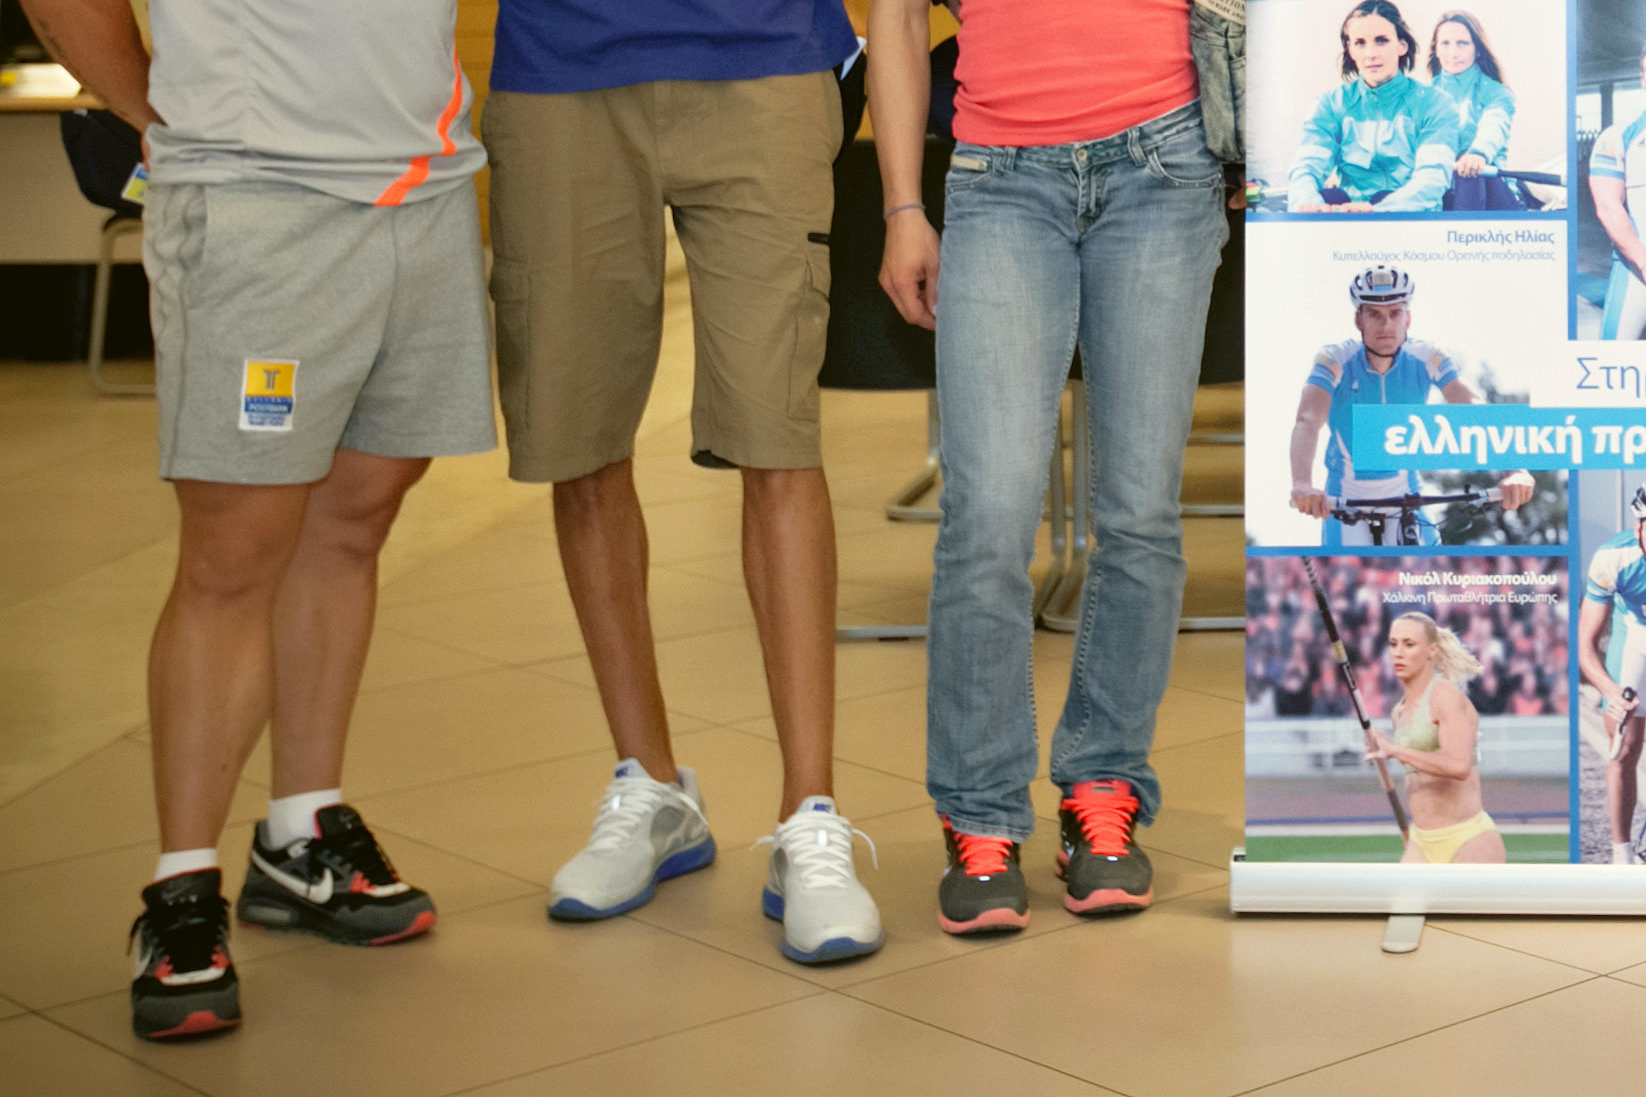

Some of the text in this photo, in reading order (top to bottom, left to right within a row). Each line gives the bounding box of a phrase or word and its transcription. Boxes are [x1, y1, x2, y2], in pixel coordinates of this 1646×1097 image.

[1447, 230, 1555, 246] Περικλής Ηλίας
[1332, 248, 1555, 263] Κυπελλούχος Κόσμου Ορεινής ποδηλασίας
[1384, 414, 1583, 465] ελληνική
[1399, 571, 1558, 588] Νικόλ Κυριακοπούλου
[1382, 591, 1558, 605] Χάλκινη Πρωταθλήτρια Ευρώπης
